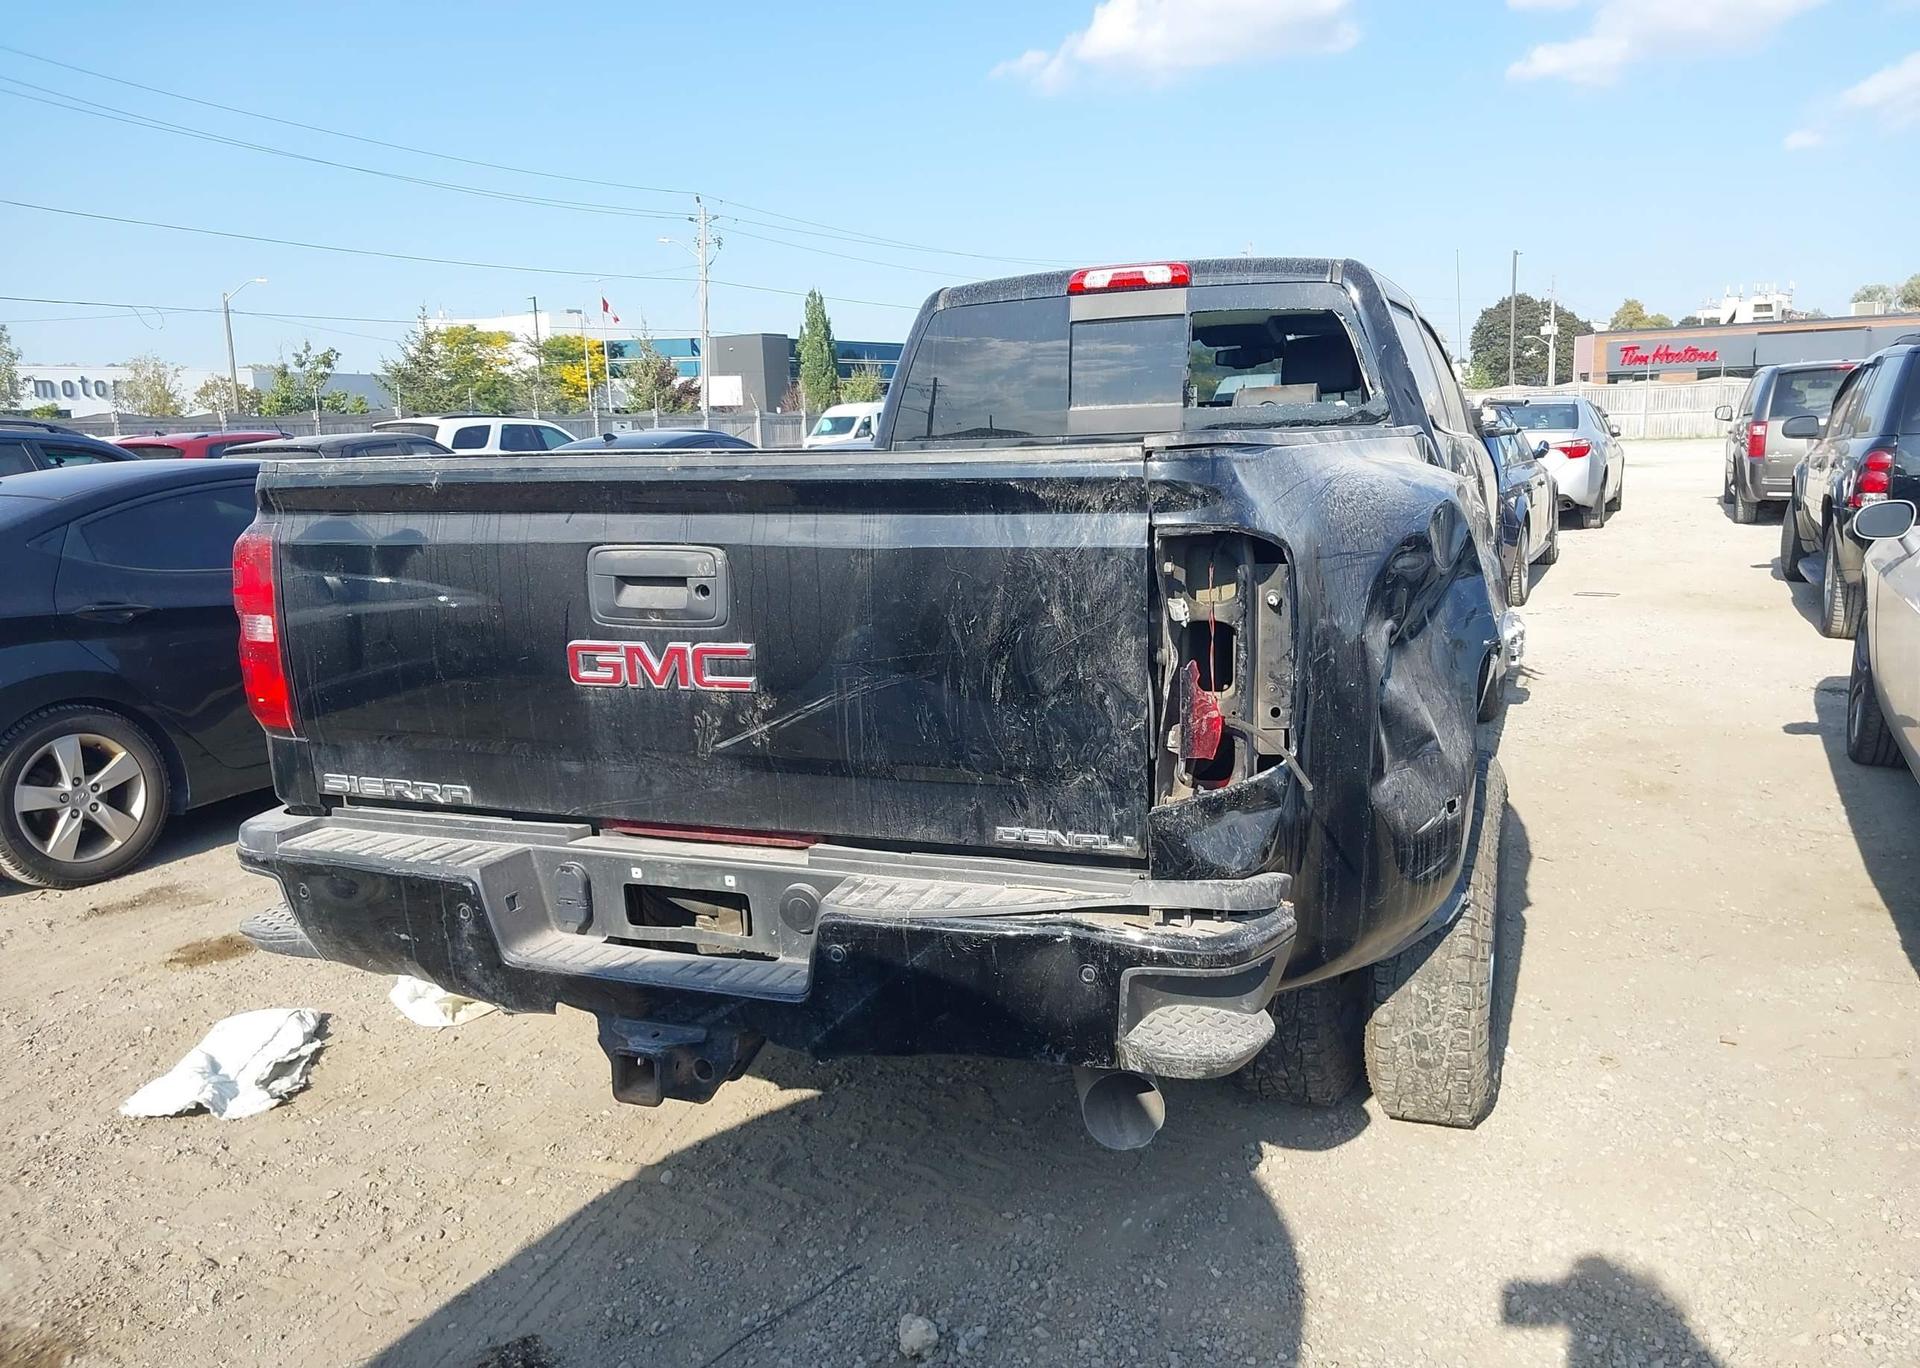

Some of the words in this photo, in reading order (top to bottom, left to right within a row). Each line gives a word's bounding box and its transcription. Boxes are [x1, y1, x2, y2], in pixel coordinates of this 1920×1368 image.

[1620, 344, 1649, 366] Tim
[1651, 344, 1718, 364] Hortons
[566, 639, 757, 692] GMC
[323, 773, 472, 804] SIERRA
[995, 826, 1135, 850] DENALI
